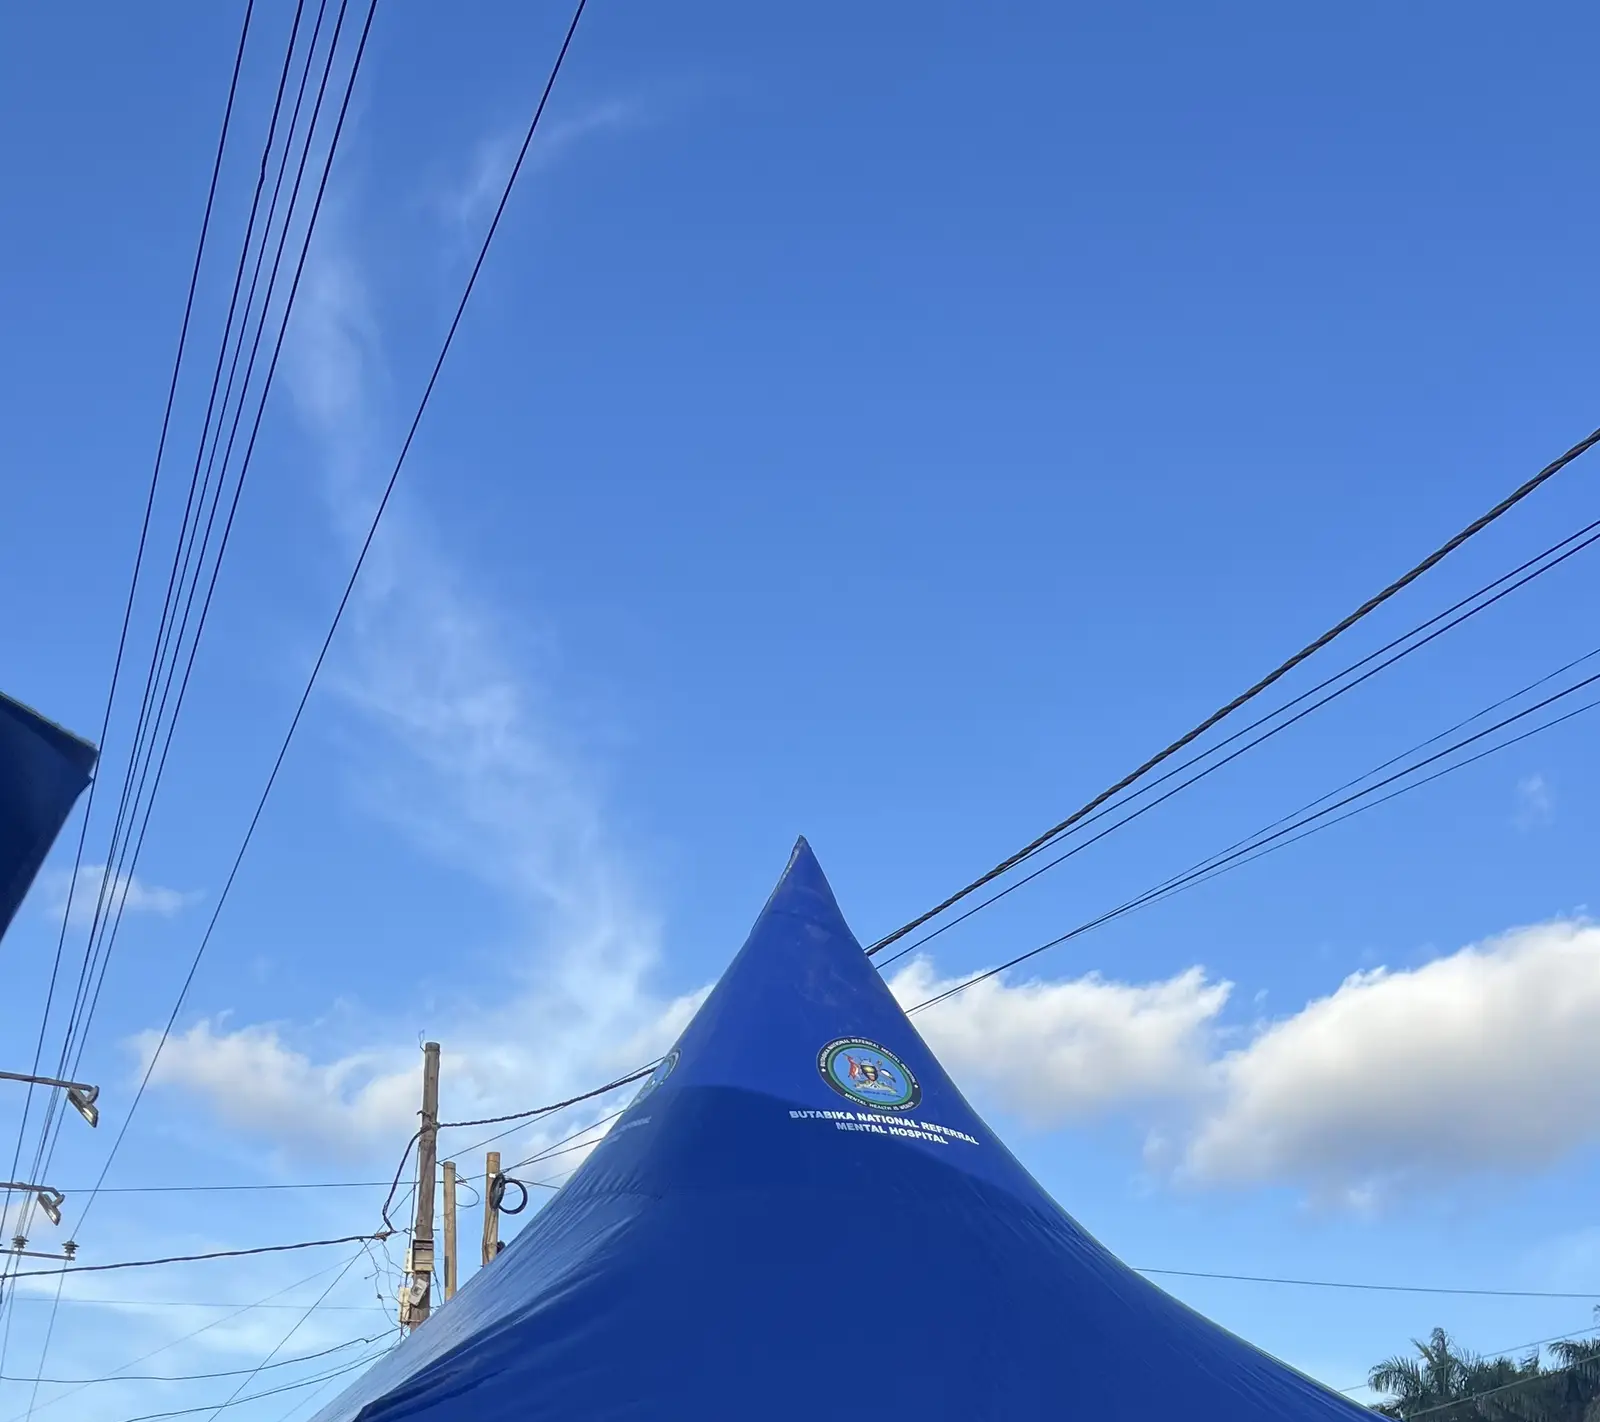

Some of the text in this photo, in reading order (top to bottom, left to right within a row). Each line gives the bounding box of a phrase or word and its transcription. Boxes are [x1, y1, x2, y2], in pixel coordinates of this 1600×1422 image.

[844, 1092, 868, 1106] MENTAL
[789, 1110, 980, 1146] BUTABIKA NATIONAL REFERRAL
[836, 1122, 949, 1145] MENTAL HOSPITAL
